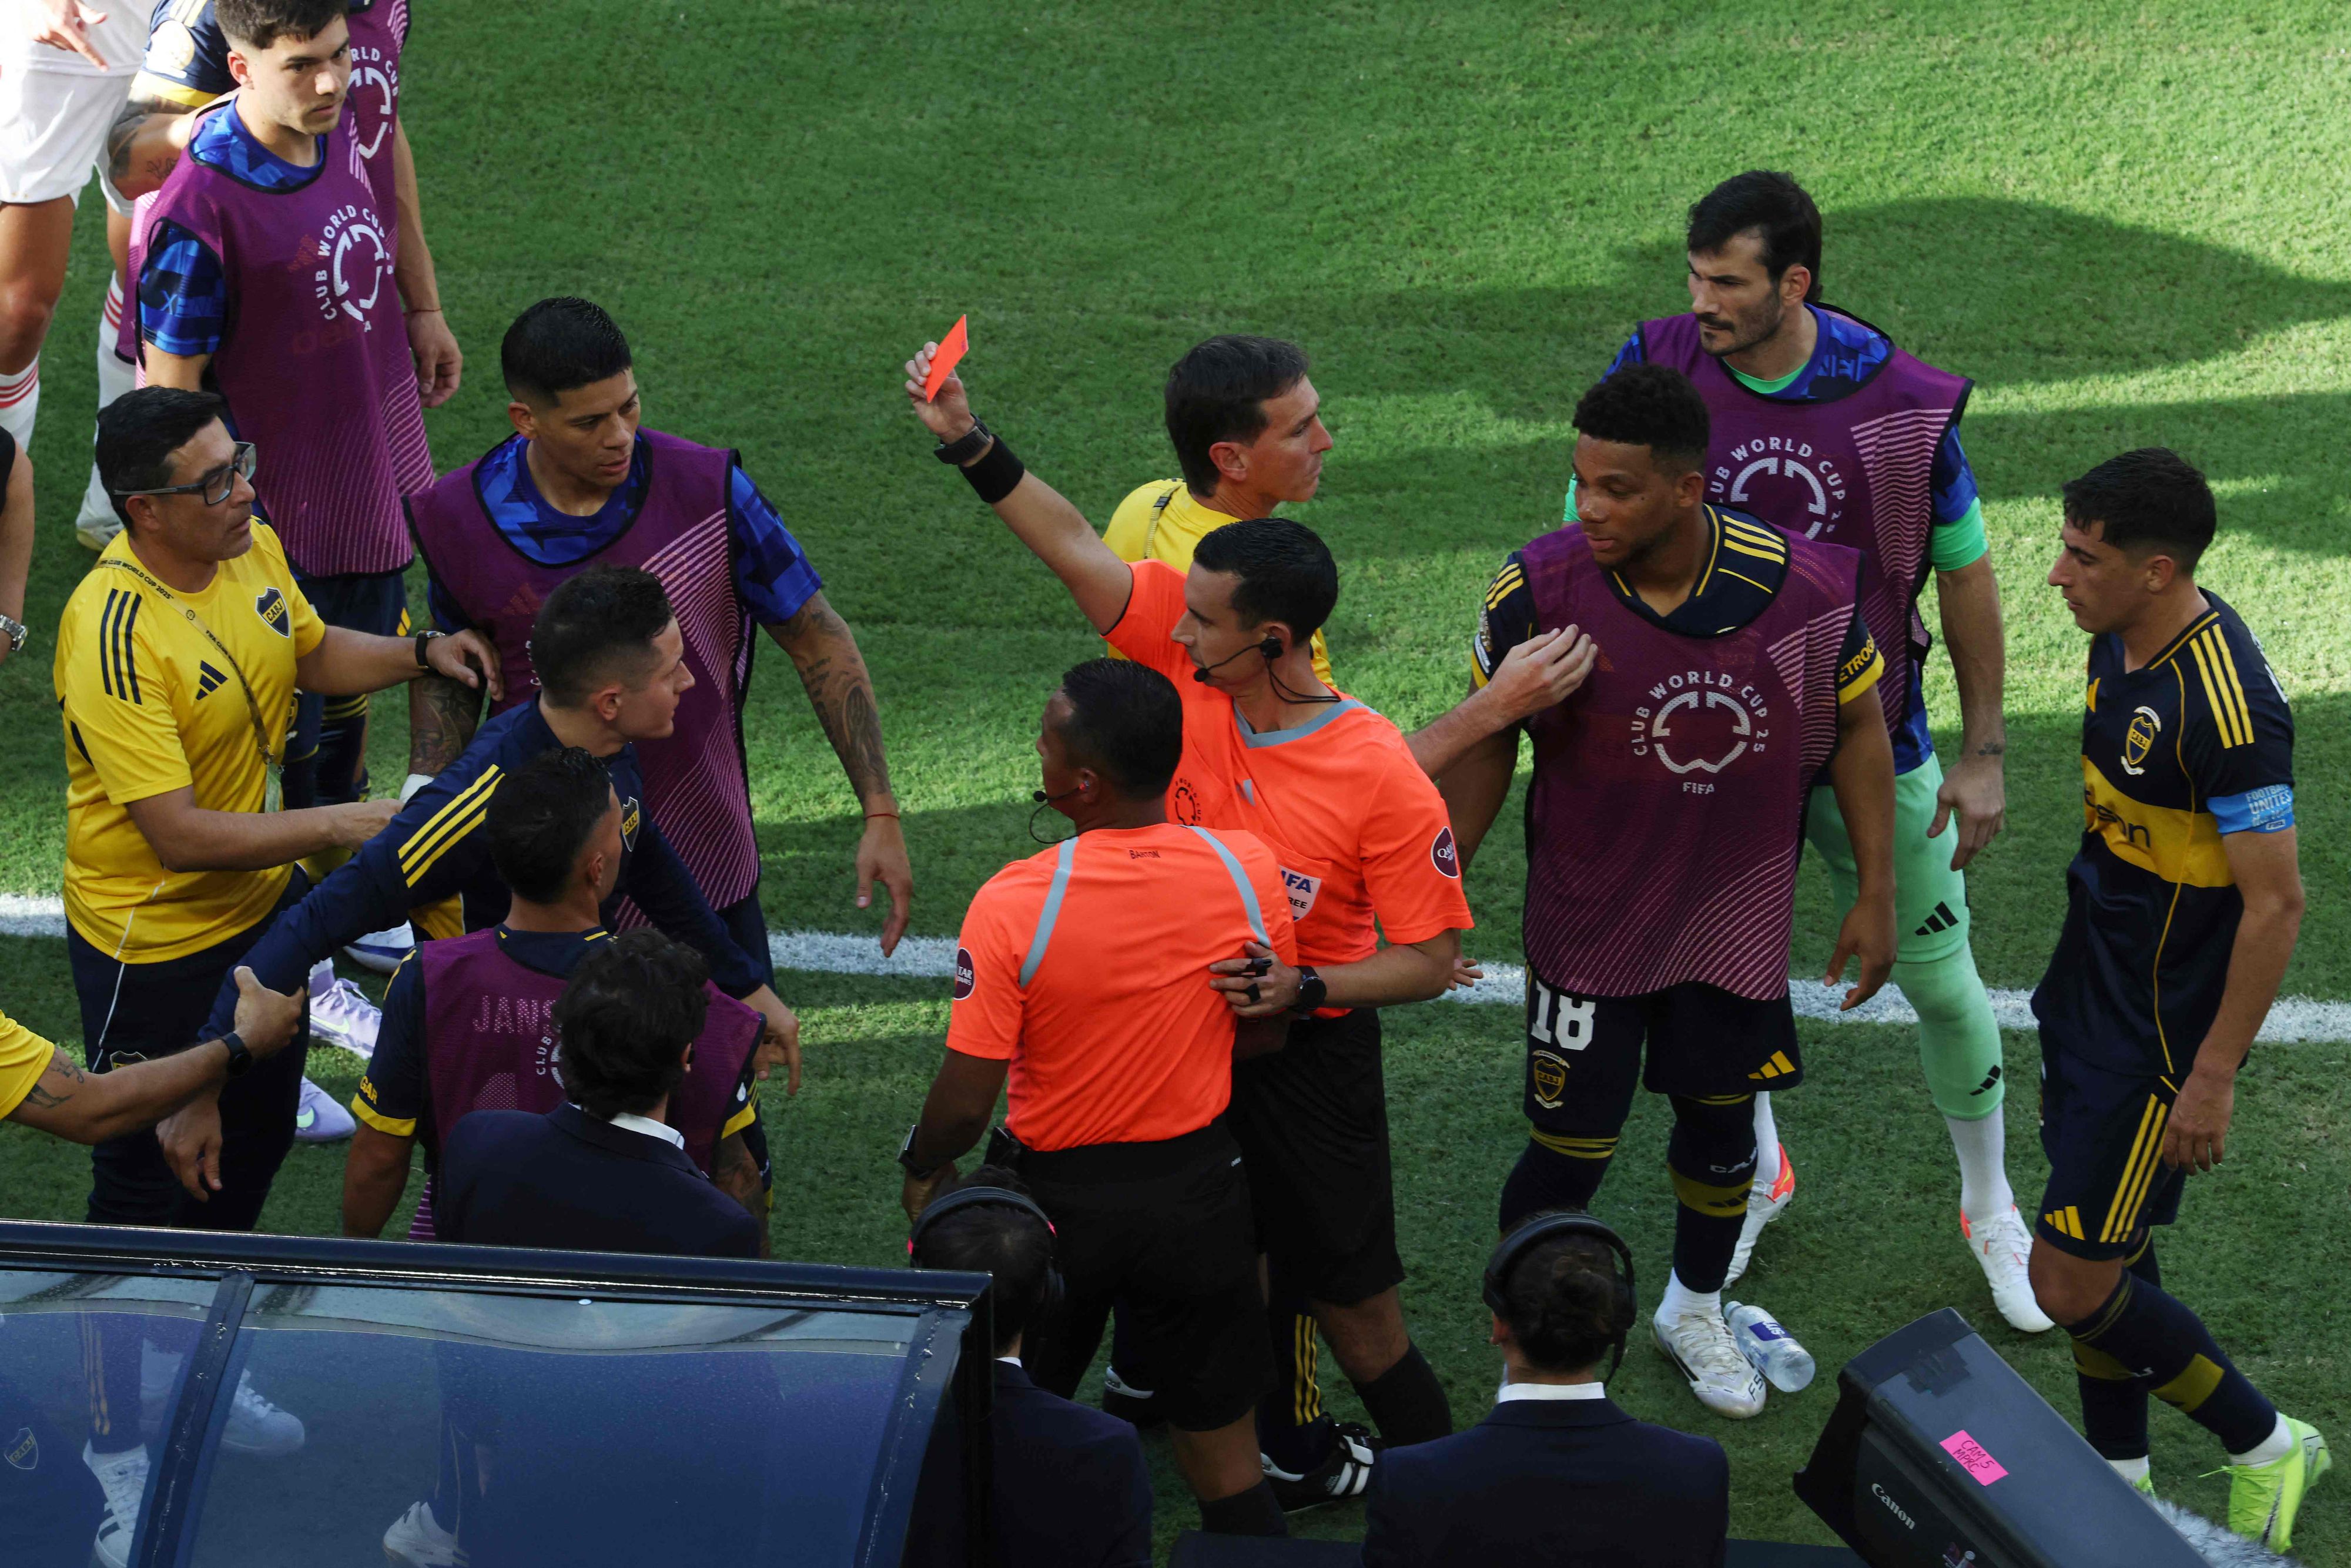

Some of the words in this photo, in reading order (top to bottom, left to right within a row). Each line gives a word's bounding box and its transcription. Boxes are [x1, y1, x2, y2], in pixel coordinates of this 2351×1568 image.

[350, 46, 381, 62] RLD
[318, 205, 357, 256] WORLD
[315, 270, 337, 320] CLUB
[1730, 437, 1813, 461] WORLD
[1818, 461, 1846, 500] CUP
[122, 562, 145, 577] WORLD
[144, 576, 157, 587] CUP
[156, 585, 172, 599] 2025
[266, 601, 283, 621] CABJ
[1648, 671, 1733, 699] WORLD
[1741, 686, 1768, 718] CUP
[1631, 706, 1650, 756] CLUB
[1753, 729, 1769, 752] 25
[1683, 782, 1715, 794] FIFA
[2249, 790, 2292, 815] UNITES
[958, 966, 973, 980] TAR
[1531, 980, 1596, 1051] 18
[535, 1036, 552, 1076] CLUB
[1961, 1440, 1986, 1462] CAM
[1980, 1460, 1995, 1469] 5
[1871, 1483, 1915, 1530] Canon
